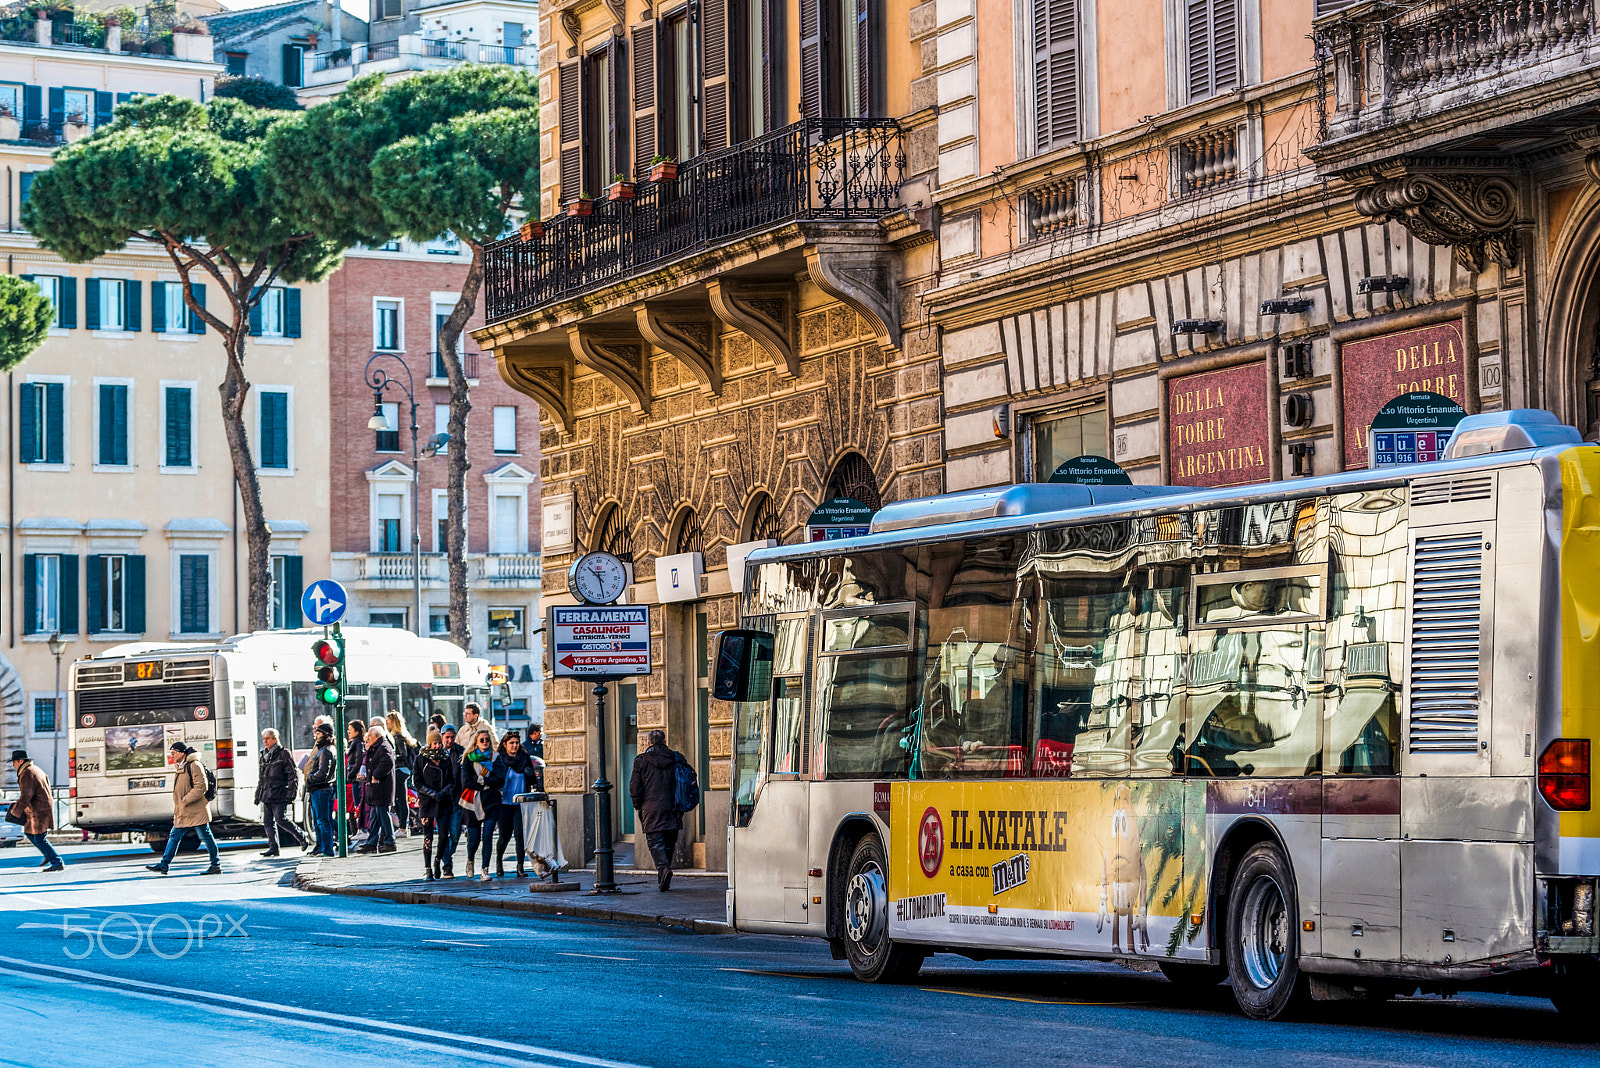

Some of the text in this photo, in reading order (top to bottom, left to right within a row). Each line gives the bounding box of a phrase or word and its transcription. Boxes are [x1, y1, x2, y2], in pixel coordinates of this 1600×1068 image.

[1396, 340, 1457, 372] DELLA
[1483, 367, 1500, 386] 100
[1175, 386, 1225, 415] DELLA
[1397, 405, 1425, 414] Vittorio
[1426, 405, 1464, 413] Emanuele
[1406, 416, 1438, 424] (Argentina)
[1175, 417, 1226, 446] TORRE
[1117, 435, 1128, 454] 96
[1418, 439, 1426, 450] e
[1177, 445, 1265, 478] ARGENTINA
[1377, 454, 1392, 463] 916
[1398, 453, 1412, 462] 916
[1418, 453, 1428, 462] C3
[1068, 467, 1093, 475] Vittorio
[1076, 476, 1104, 484] (Argentina)
[559, 611, 644, 622] FERRAMENTA
[572, 626, 630, 634] CASALINGHI
[573, 656, 584, 664] Via
[607, 656, 638, 665] Argentina,
[137, 663, 154, 679] 87
[77, 763, 100, 772] 4274
[1242, 786, 1266, 808] 7541
[950, 810, 1067, 852] IL NATALE
[923, 821, 939, 860] 25
[950, 865, 955, 876] a
[956, 865, 974, 877] casa
[975, 865, 989, 877] con
